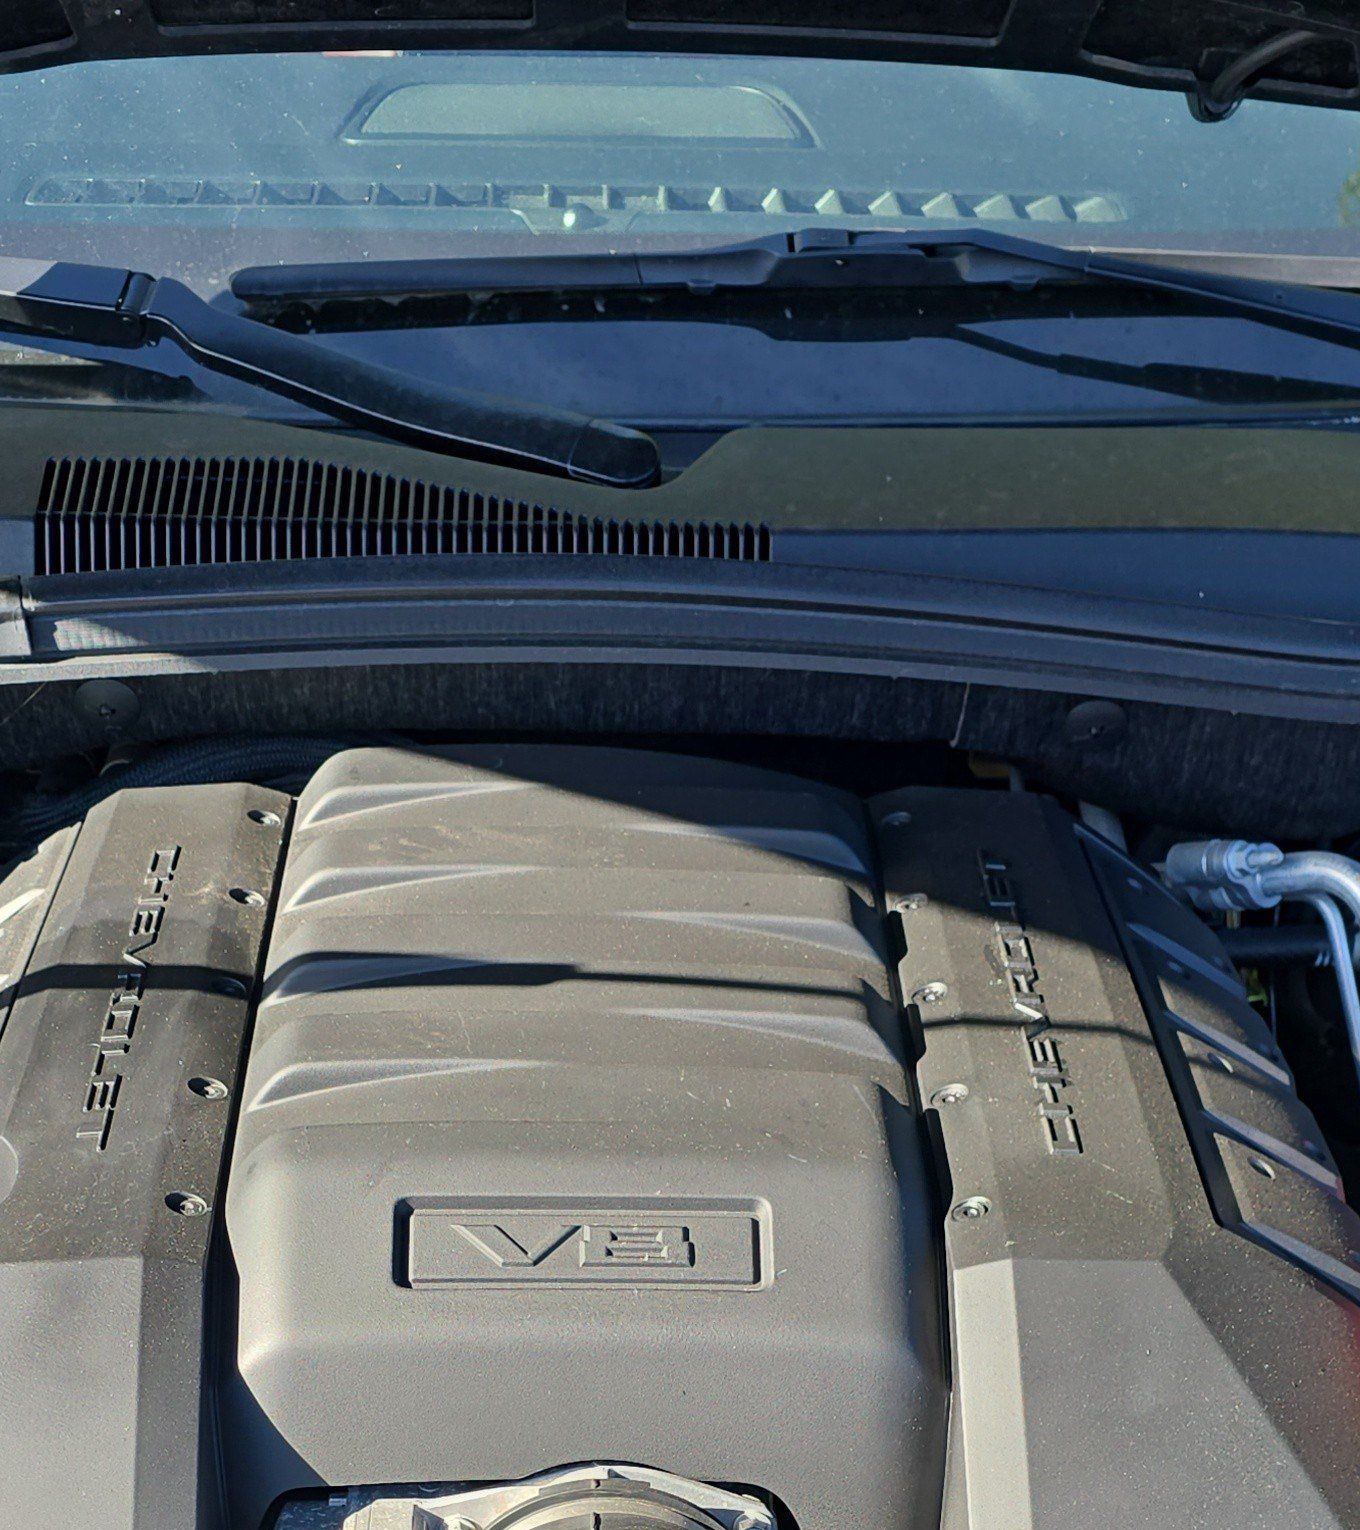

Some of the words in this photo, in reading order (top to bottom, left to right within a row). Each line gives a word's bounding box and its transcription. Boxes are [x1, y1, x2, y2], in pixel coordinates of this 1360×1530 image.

[76, 845, 183, 1151] CHEVROLET
[978, 850, 1084, 1154] CHEVROLET
[450, 1224, 696, 1267] V8
